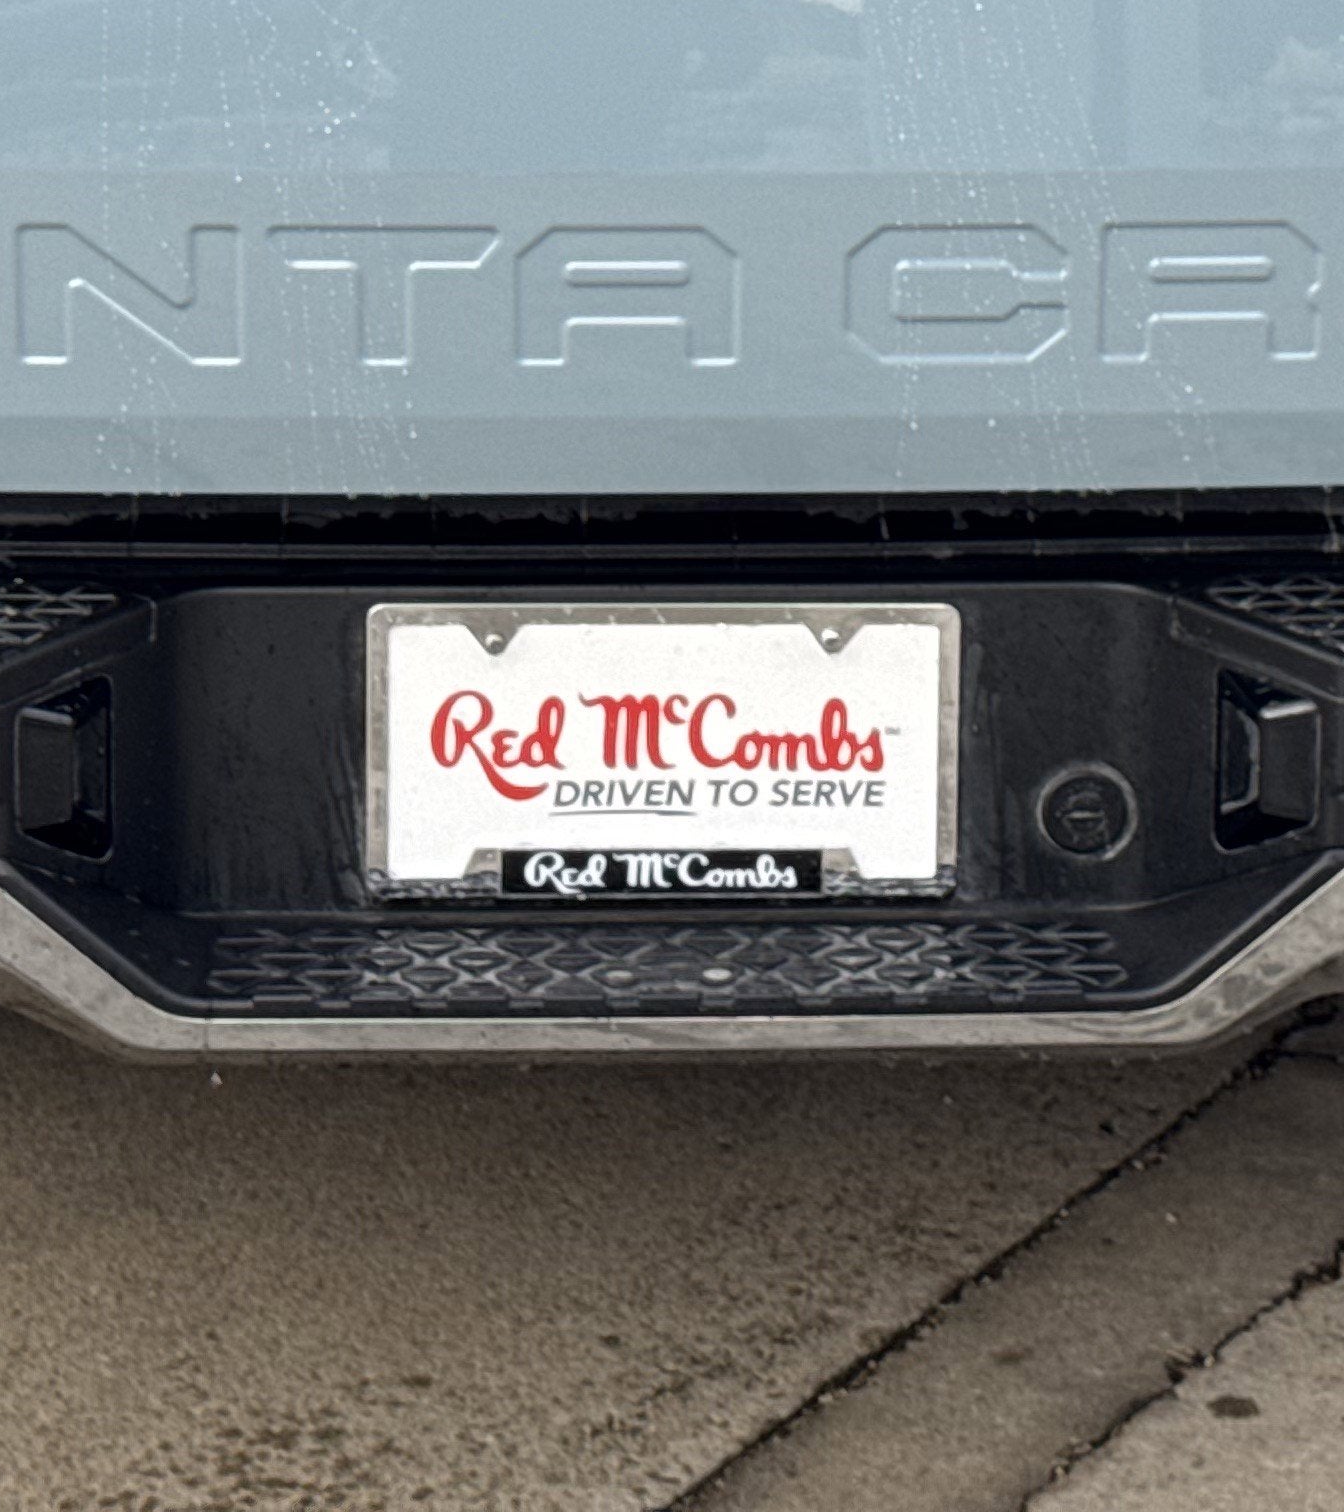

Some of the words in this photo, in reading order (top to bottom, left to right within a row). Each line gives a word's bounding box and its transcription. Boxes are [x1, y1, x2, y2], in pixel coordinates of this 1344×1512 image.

[430, 690, 565, 800] Red
[579, 693, 885, 772] McCombs
[553, 778, 696, 808] DRIVEN
[710, 779, 759, 808] TO
[768, 779, 886, 808] SERVE
[524, 851, 606, 895] Red
[612, 852, 797, 888] McCombs
